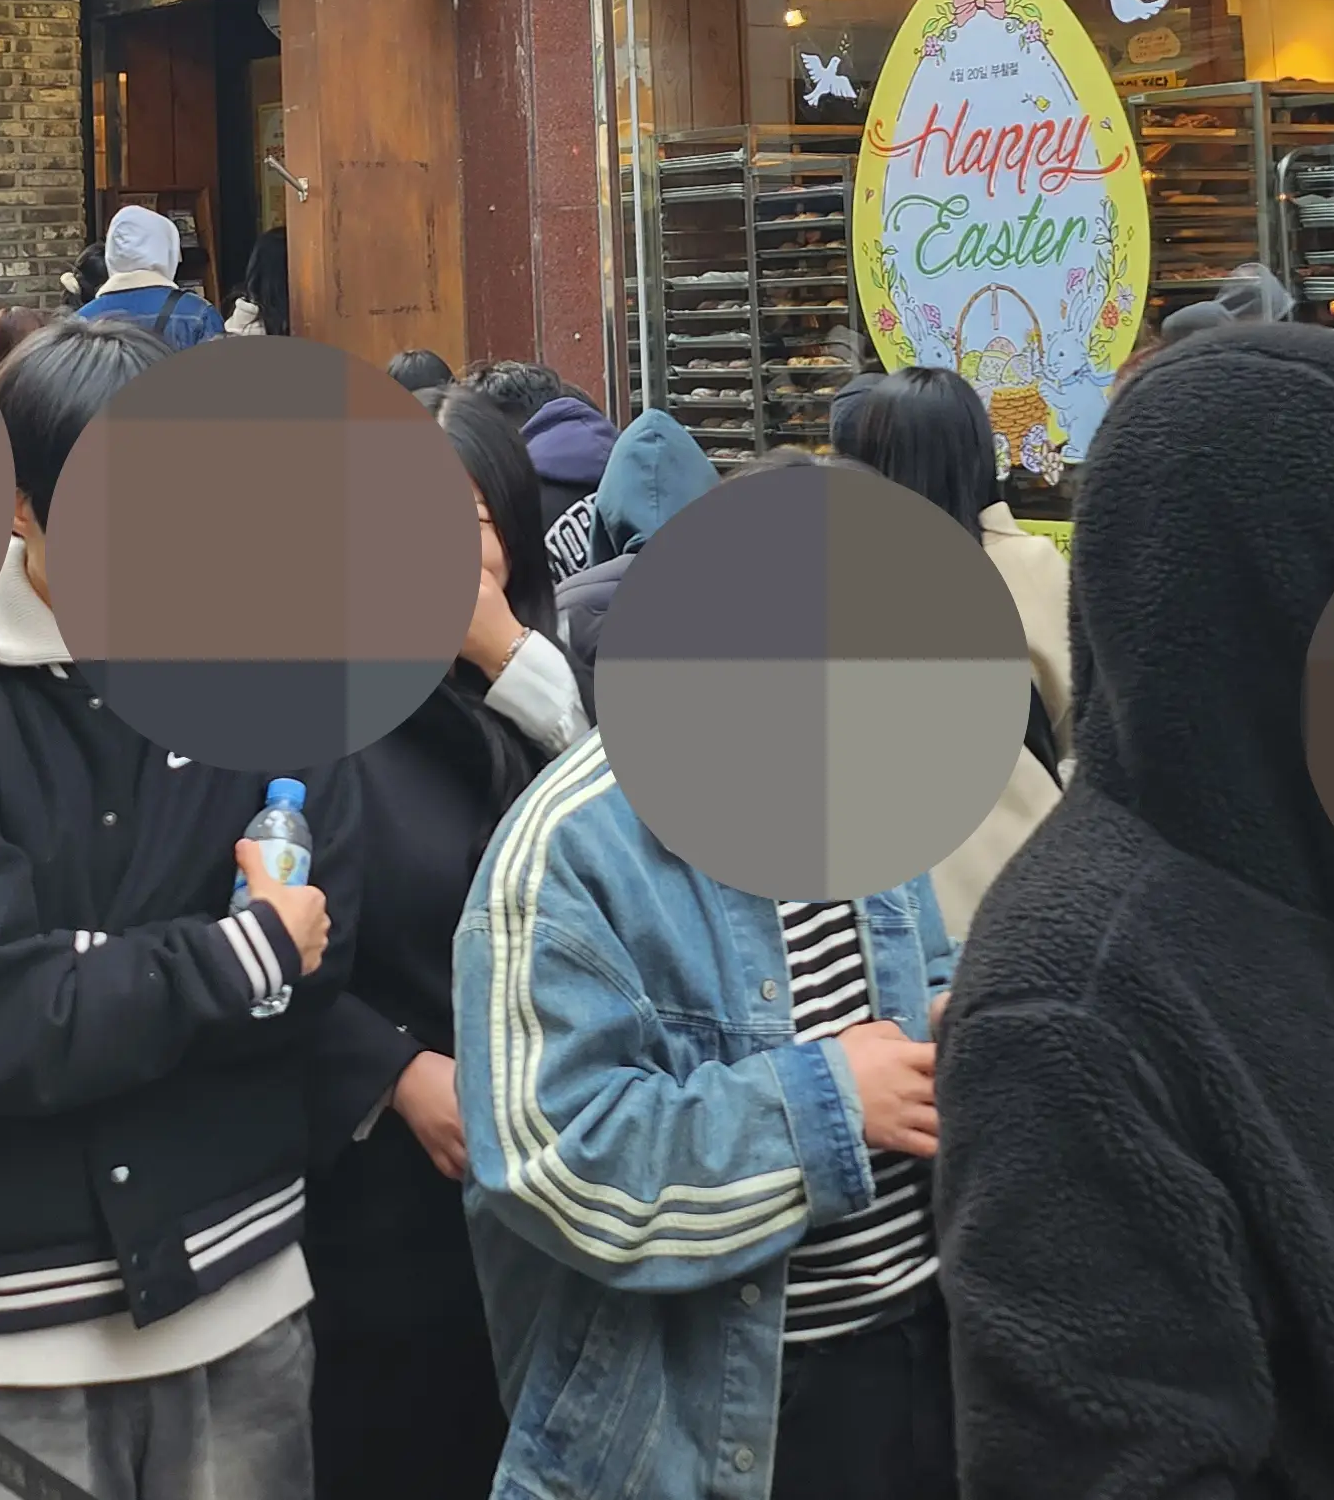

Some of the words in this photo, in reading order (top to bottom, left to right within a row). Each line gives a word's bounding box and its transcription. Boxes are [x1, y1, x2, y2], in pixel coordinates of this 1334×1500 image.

[966, 65, 989, 82] 20일
[869, 98, 1131, 197] Happy
[893, 193, 1090, 276] Easter
